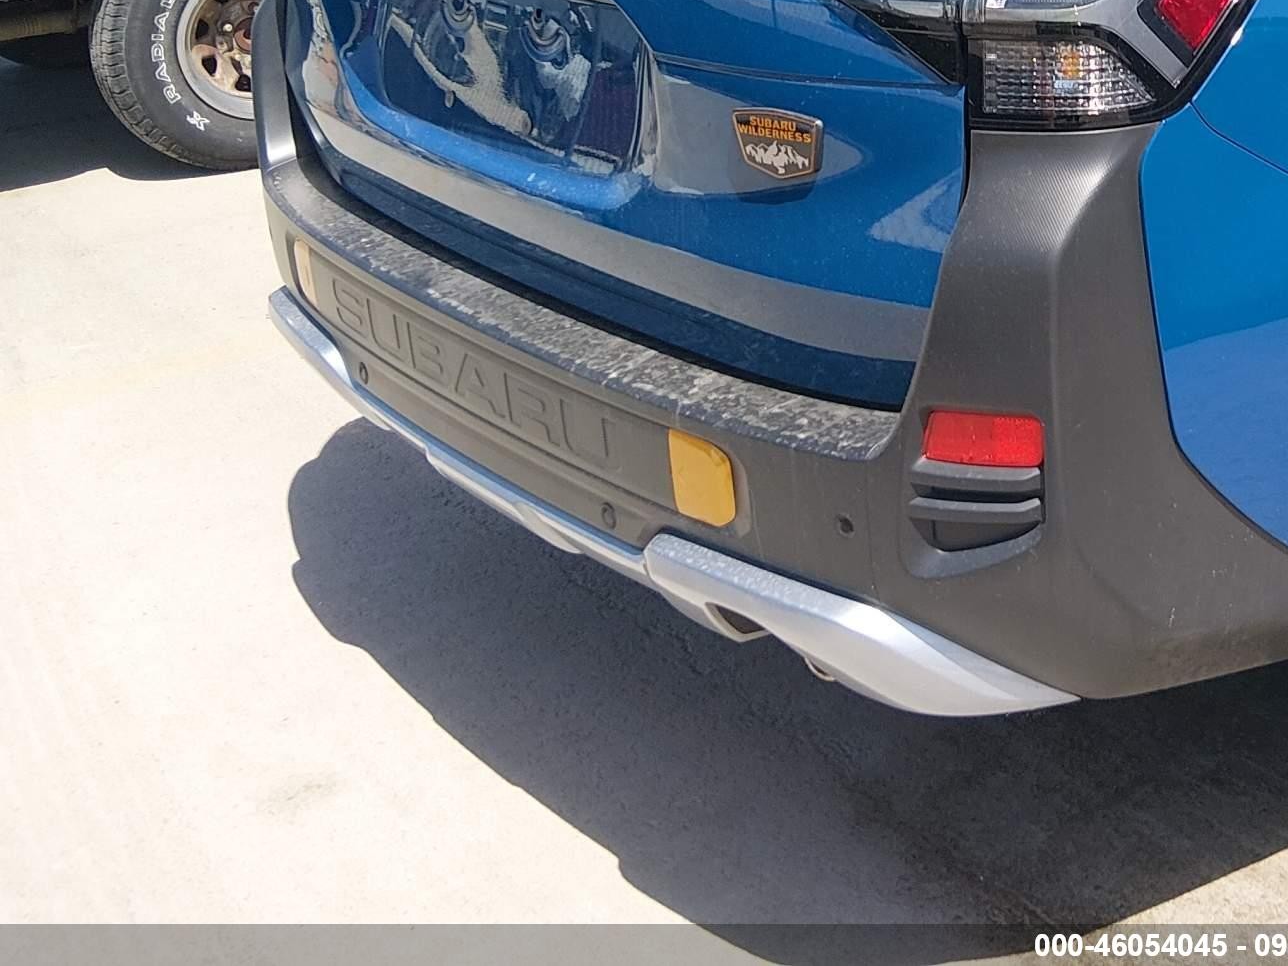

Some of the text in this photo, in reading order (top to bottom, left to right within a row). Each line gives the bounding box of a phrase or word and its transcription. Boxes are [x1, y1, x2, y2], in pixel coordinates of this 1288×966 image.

[737, 123, 812, 143] WILDERNESS
[750, 116, 797, 132] SUBARU
[332, 278, 623, 472] SUBARU
